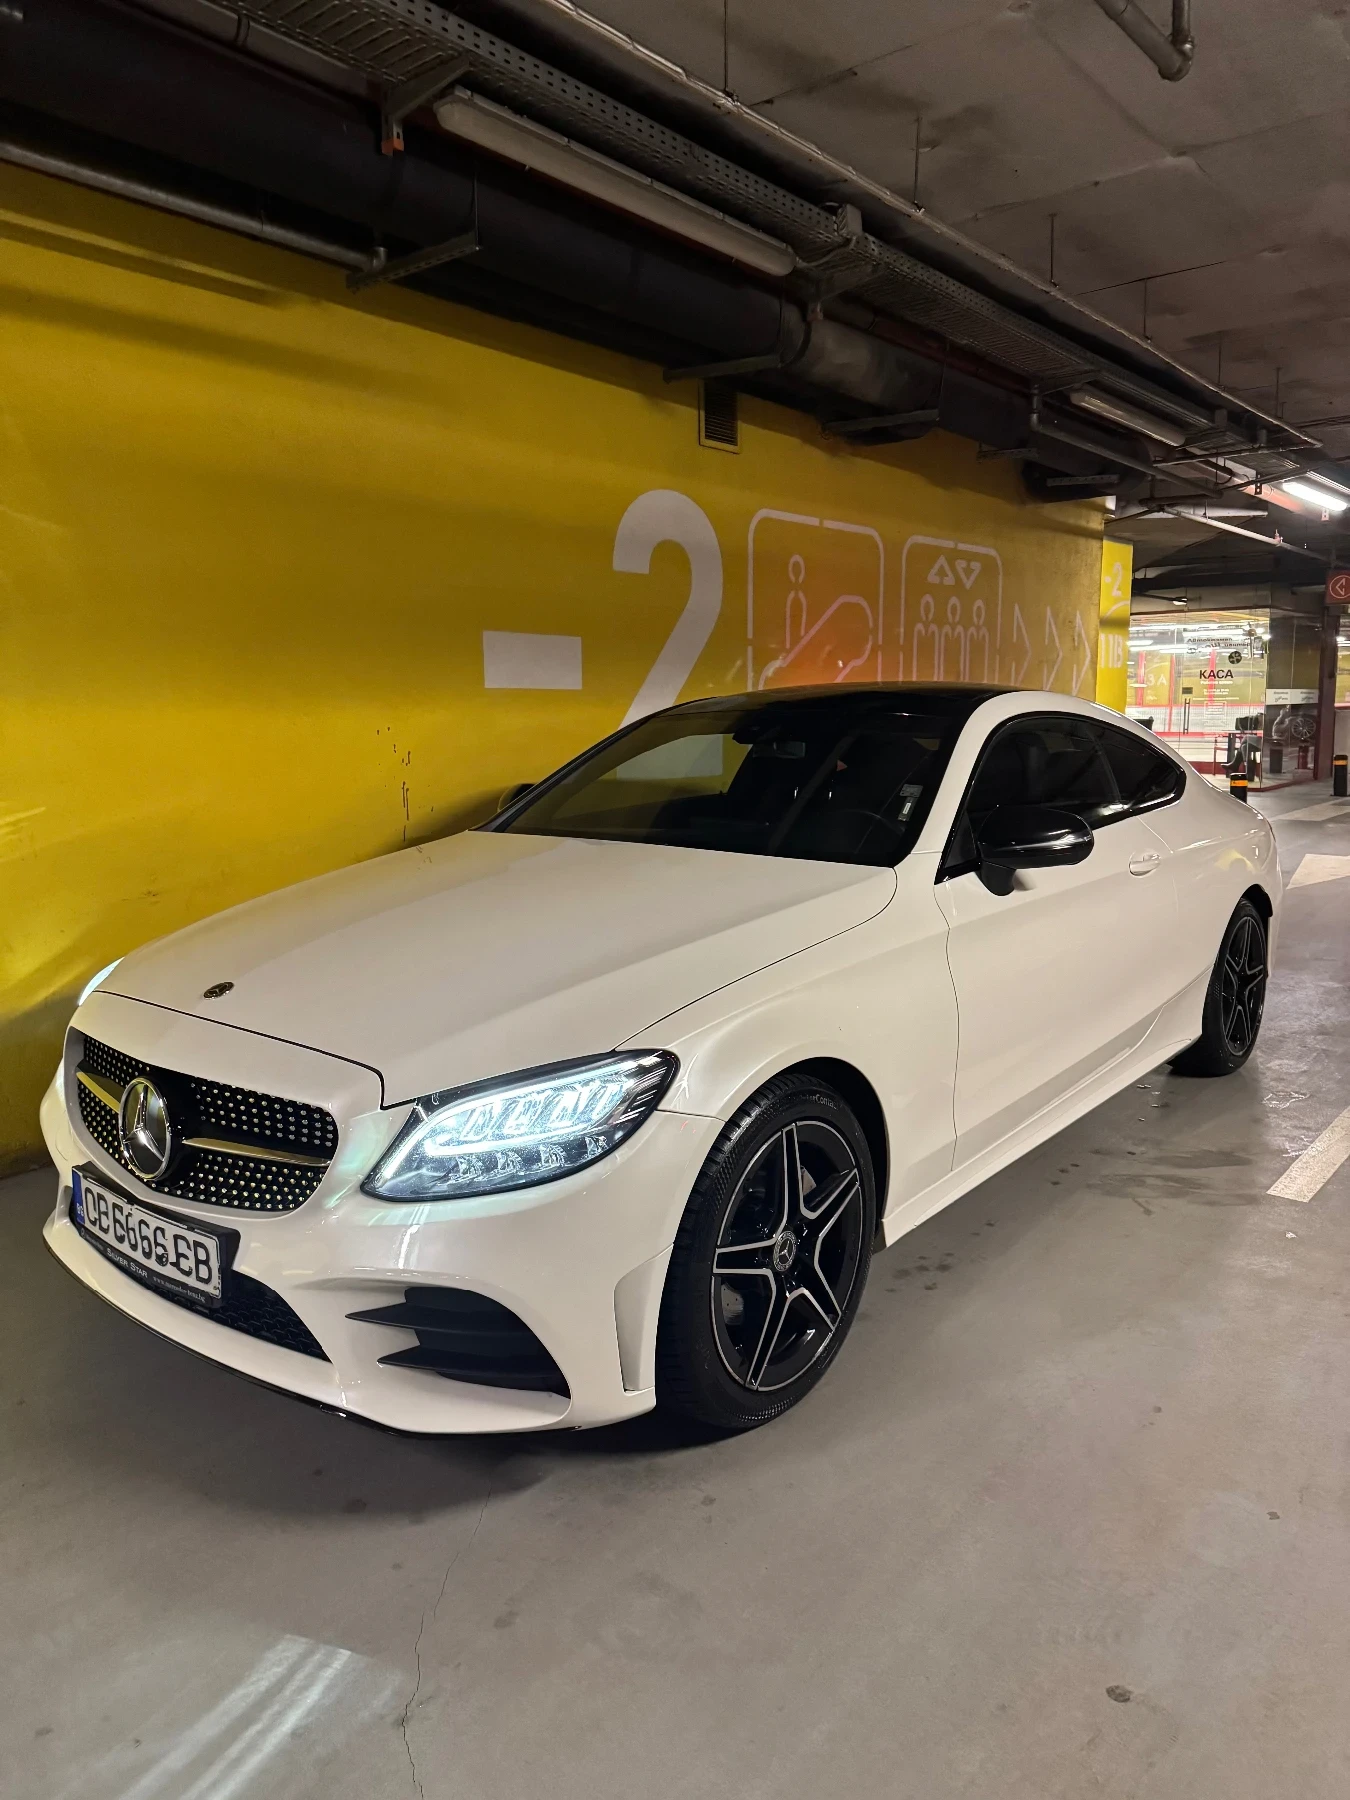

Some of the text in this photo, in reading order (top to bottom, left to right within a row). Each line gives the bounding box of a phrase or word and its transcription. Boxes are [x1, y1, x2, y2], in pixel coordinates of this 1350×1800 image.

[1199, 669, 1234, 679] КАСА
[106, 1247, 148, 1279] SILVER STAR
